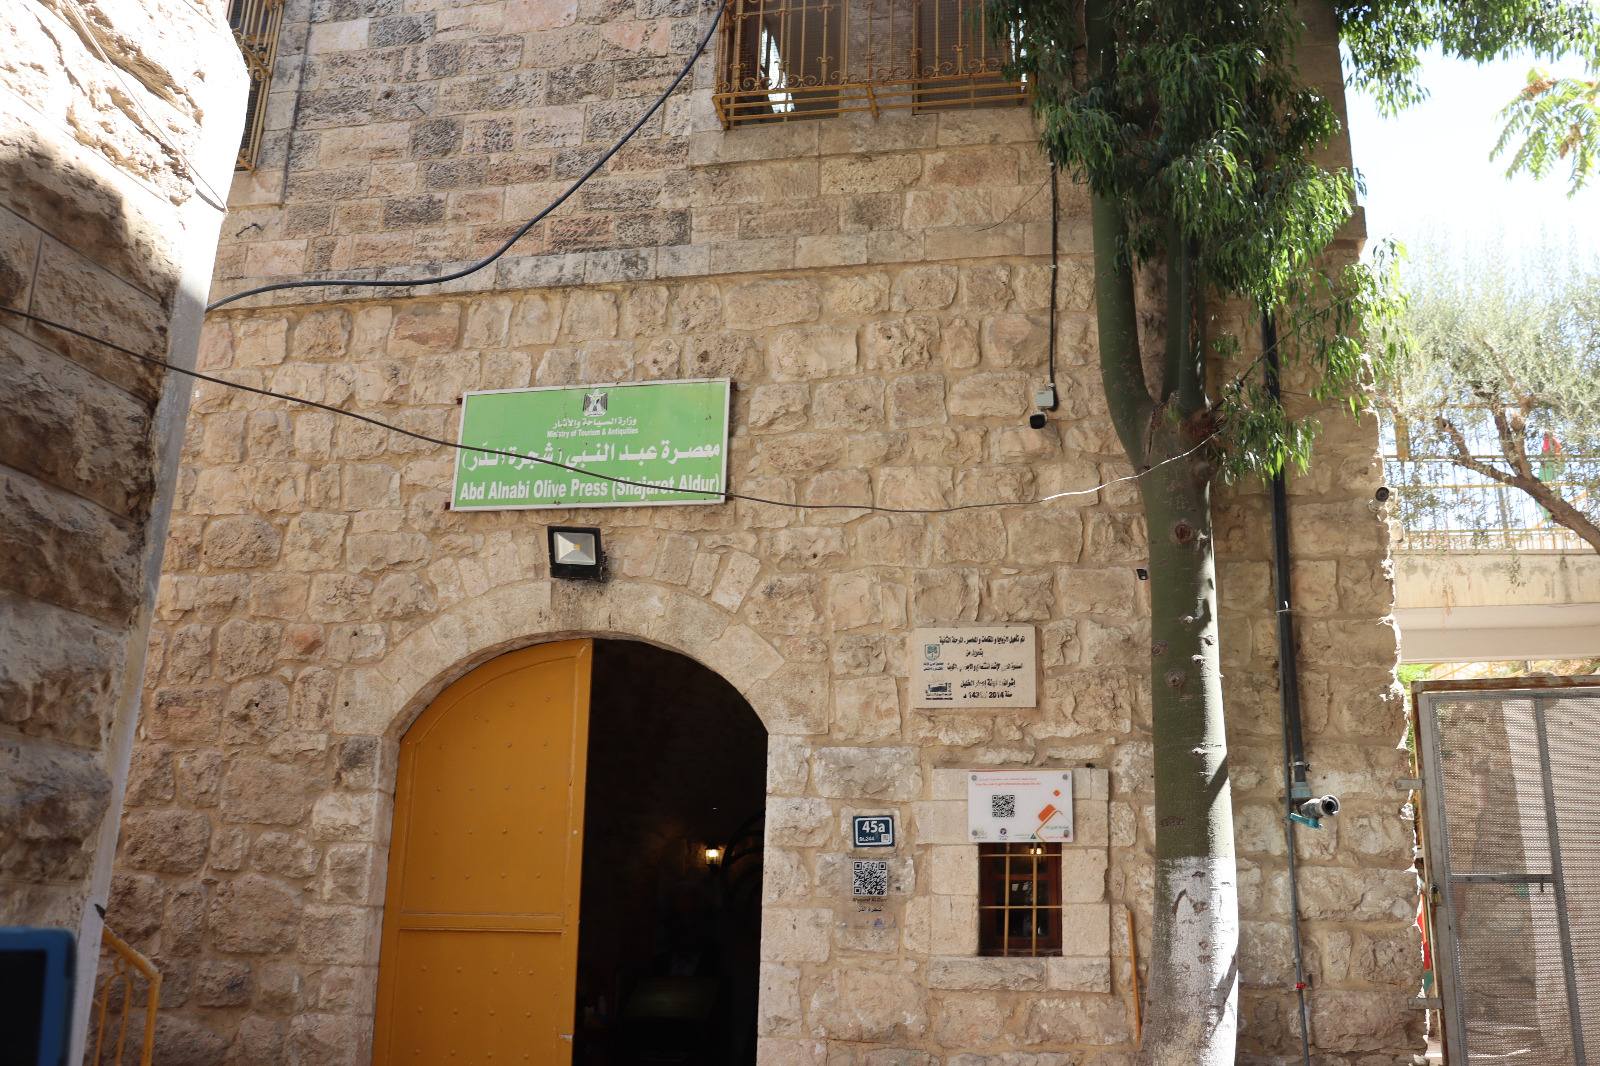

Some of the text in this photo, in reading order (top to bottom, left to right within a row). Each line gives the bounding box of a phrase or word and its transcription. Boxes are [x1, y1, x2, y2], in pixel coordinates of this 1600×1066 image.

[582, 417, 618, 428] السياحة
[619, 416, 637, 426] وزارة
[570, 429, 577, 437] of
[565, 442, 615, 473] النبي
[619, 443, 658, 466] عبد
[661, 439, 721, 465] معصرة
[459, 472, 720, 500] Abd Alnabi Olive Press (Shajaret Aldur)
[861, 820, 886, 834] 45a
